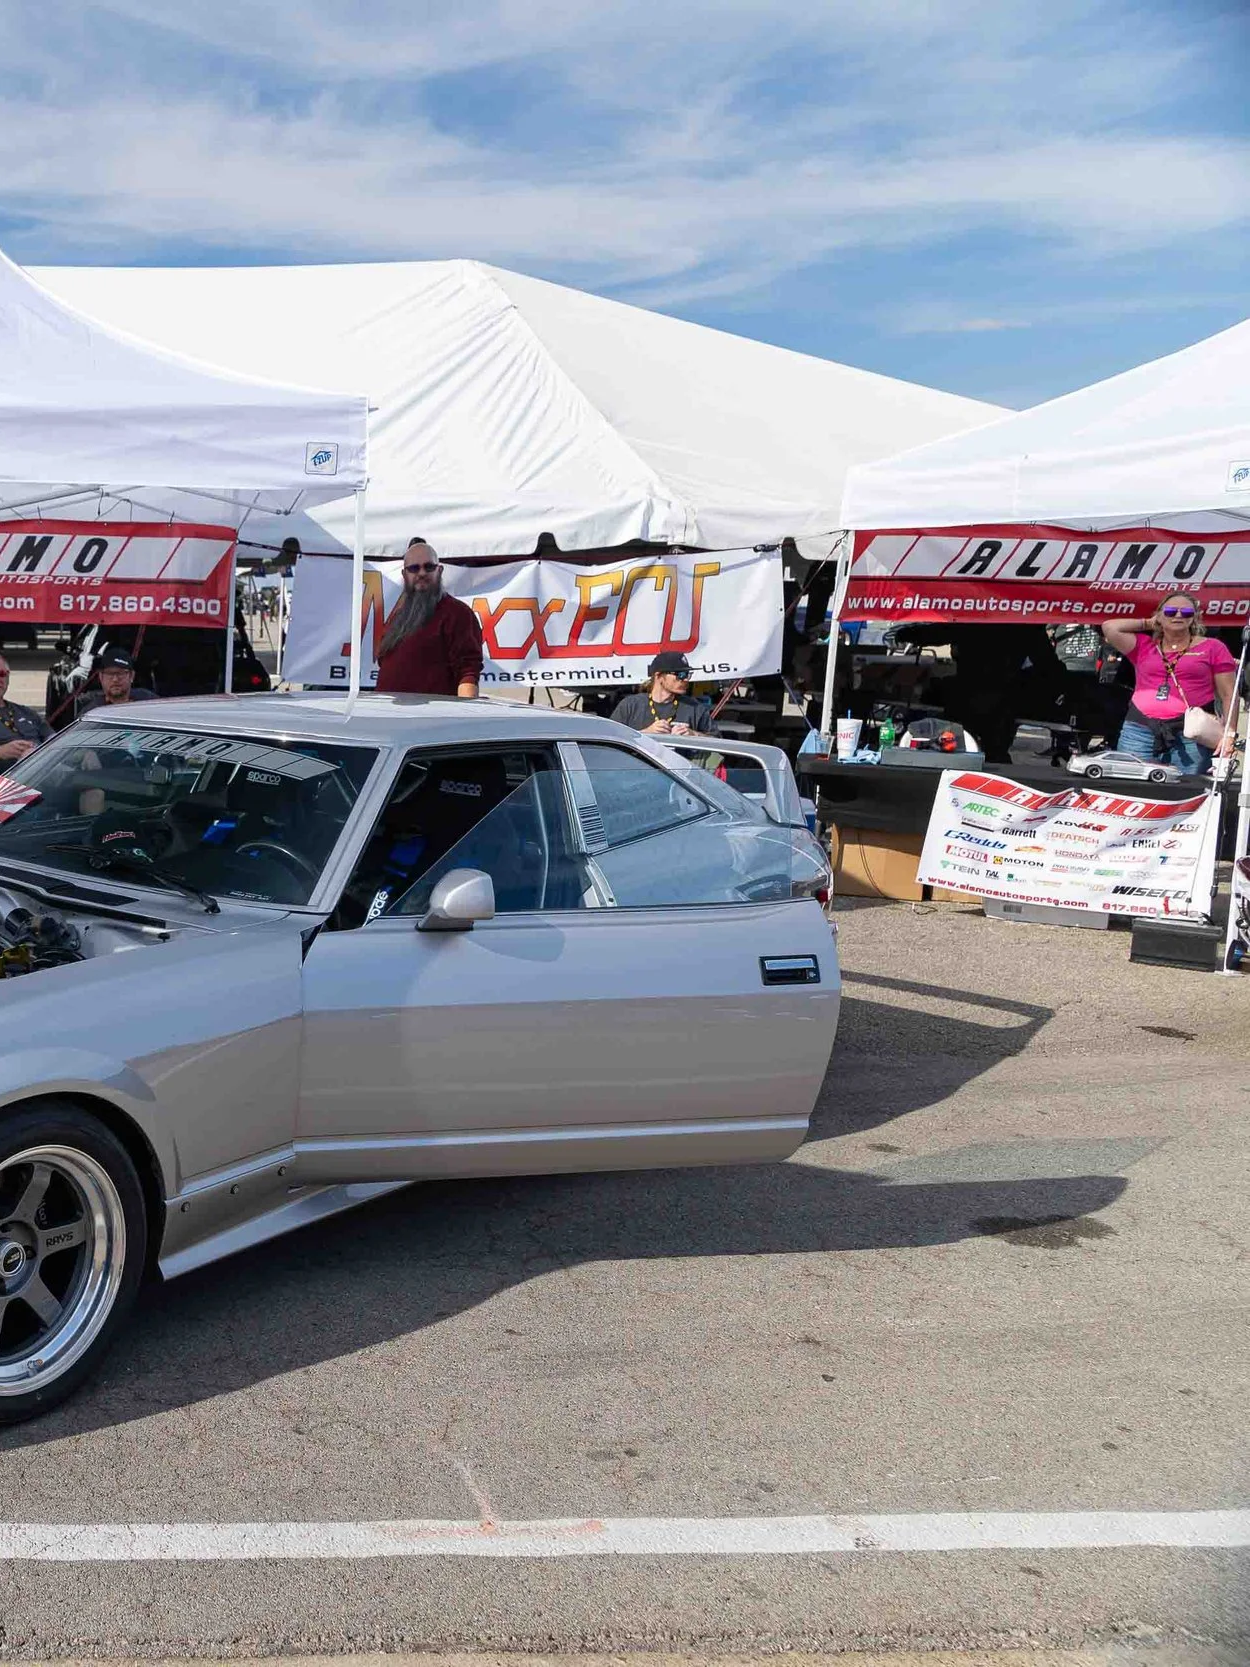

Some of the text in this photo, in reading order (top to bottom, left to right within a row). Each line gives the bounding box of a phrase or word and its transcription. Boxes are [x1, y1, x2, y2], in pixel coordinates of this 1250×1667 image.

[957, 540, 1205, 580] ALAMO
[1088, 582, 1202, 592] AUTOSPORTS
[59, 593, 222, 616] 817.860.4300
[848, 593, 1136, 616] www.alamoautosports.com
[962, 802, 1000, 818] ARTEC
[944, 829, 1008, 850] GReddy
[1001, 826, 1037, 839] Garrett
[949, 845, 988, 862] MOTUL
[949, 863, 980, 876] TEIN
[1004, 857, 1044, 868] MOTON
[45, 1231, 74, 1248] RAYS
